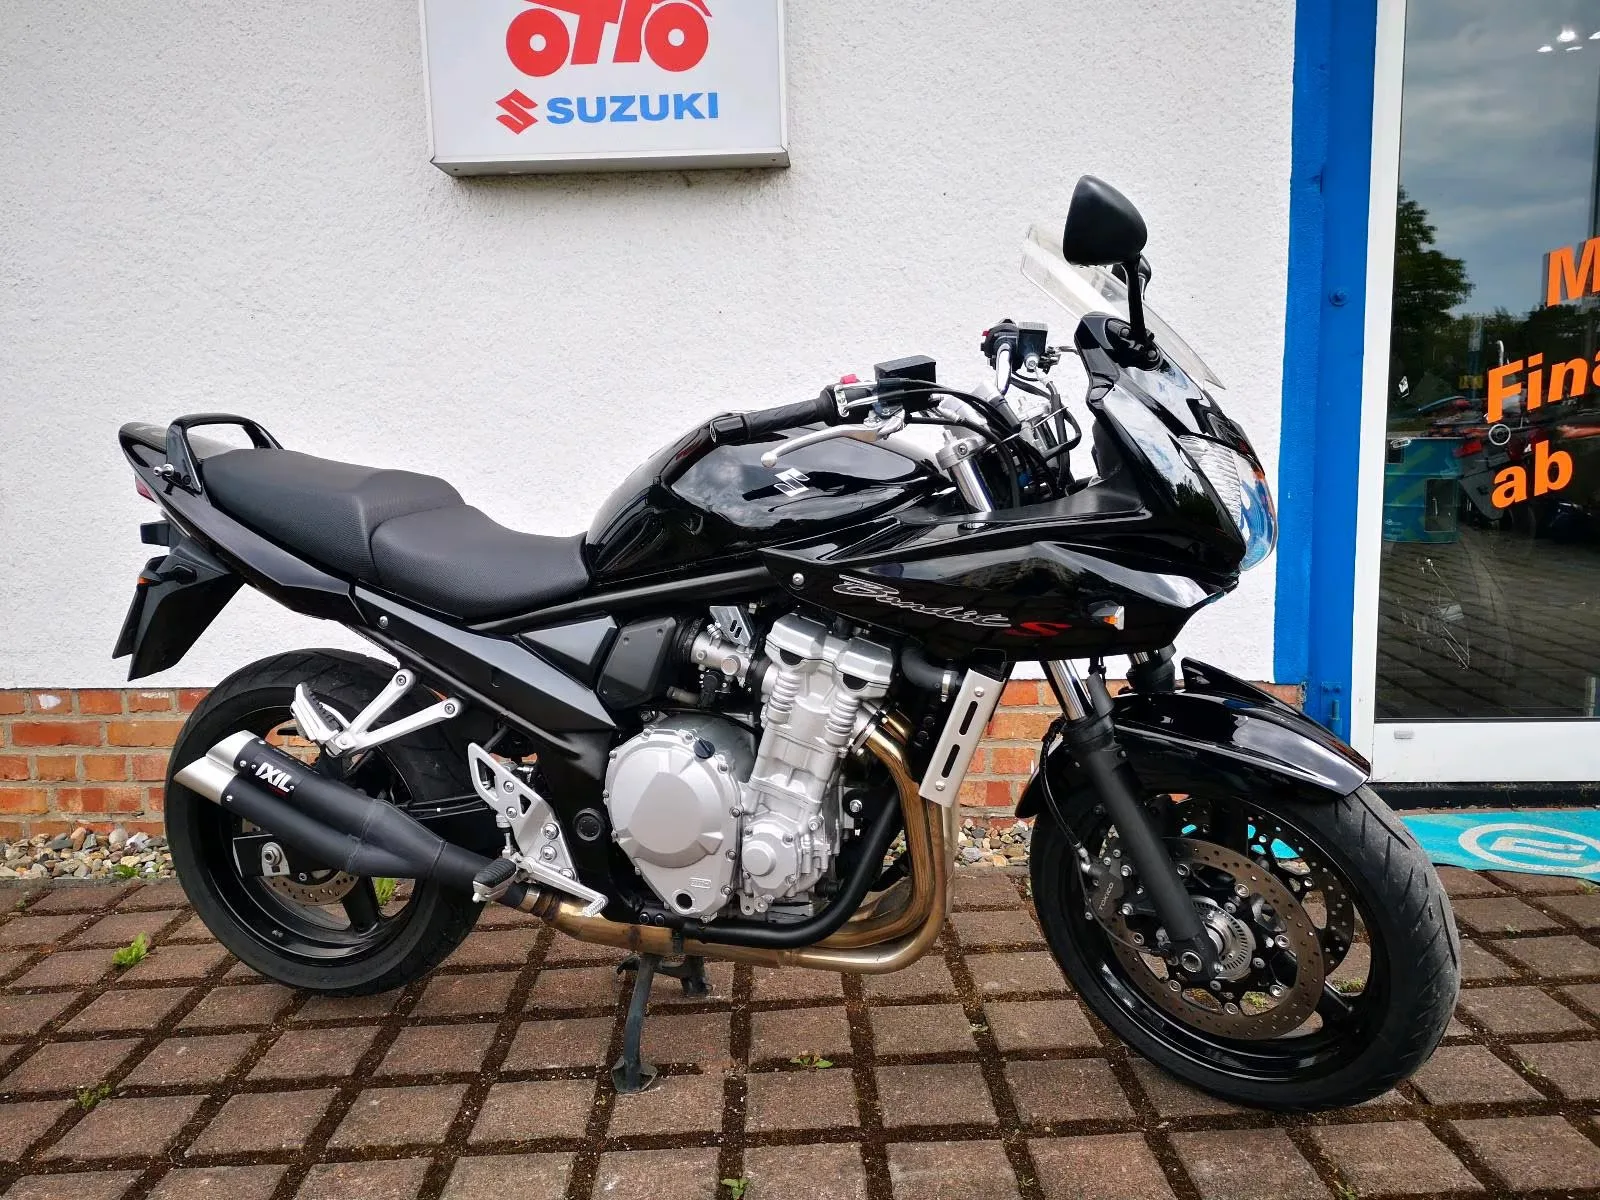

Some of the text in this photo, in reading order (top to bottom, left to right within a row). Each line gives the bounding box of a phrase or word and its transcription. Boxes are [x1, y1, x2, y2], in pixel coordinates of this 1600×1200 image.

[547, 92, 719, 125] SUZUKI
[1488, 350, 1600, 424] Fin
[1491, 440, 1573, 509] ab
[833, 574, 1011, 627] Bandit
[255, 762, 292, 792] IXIL
